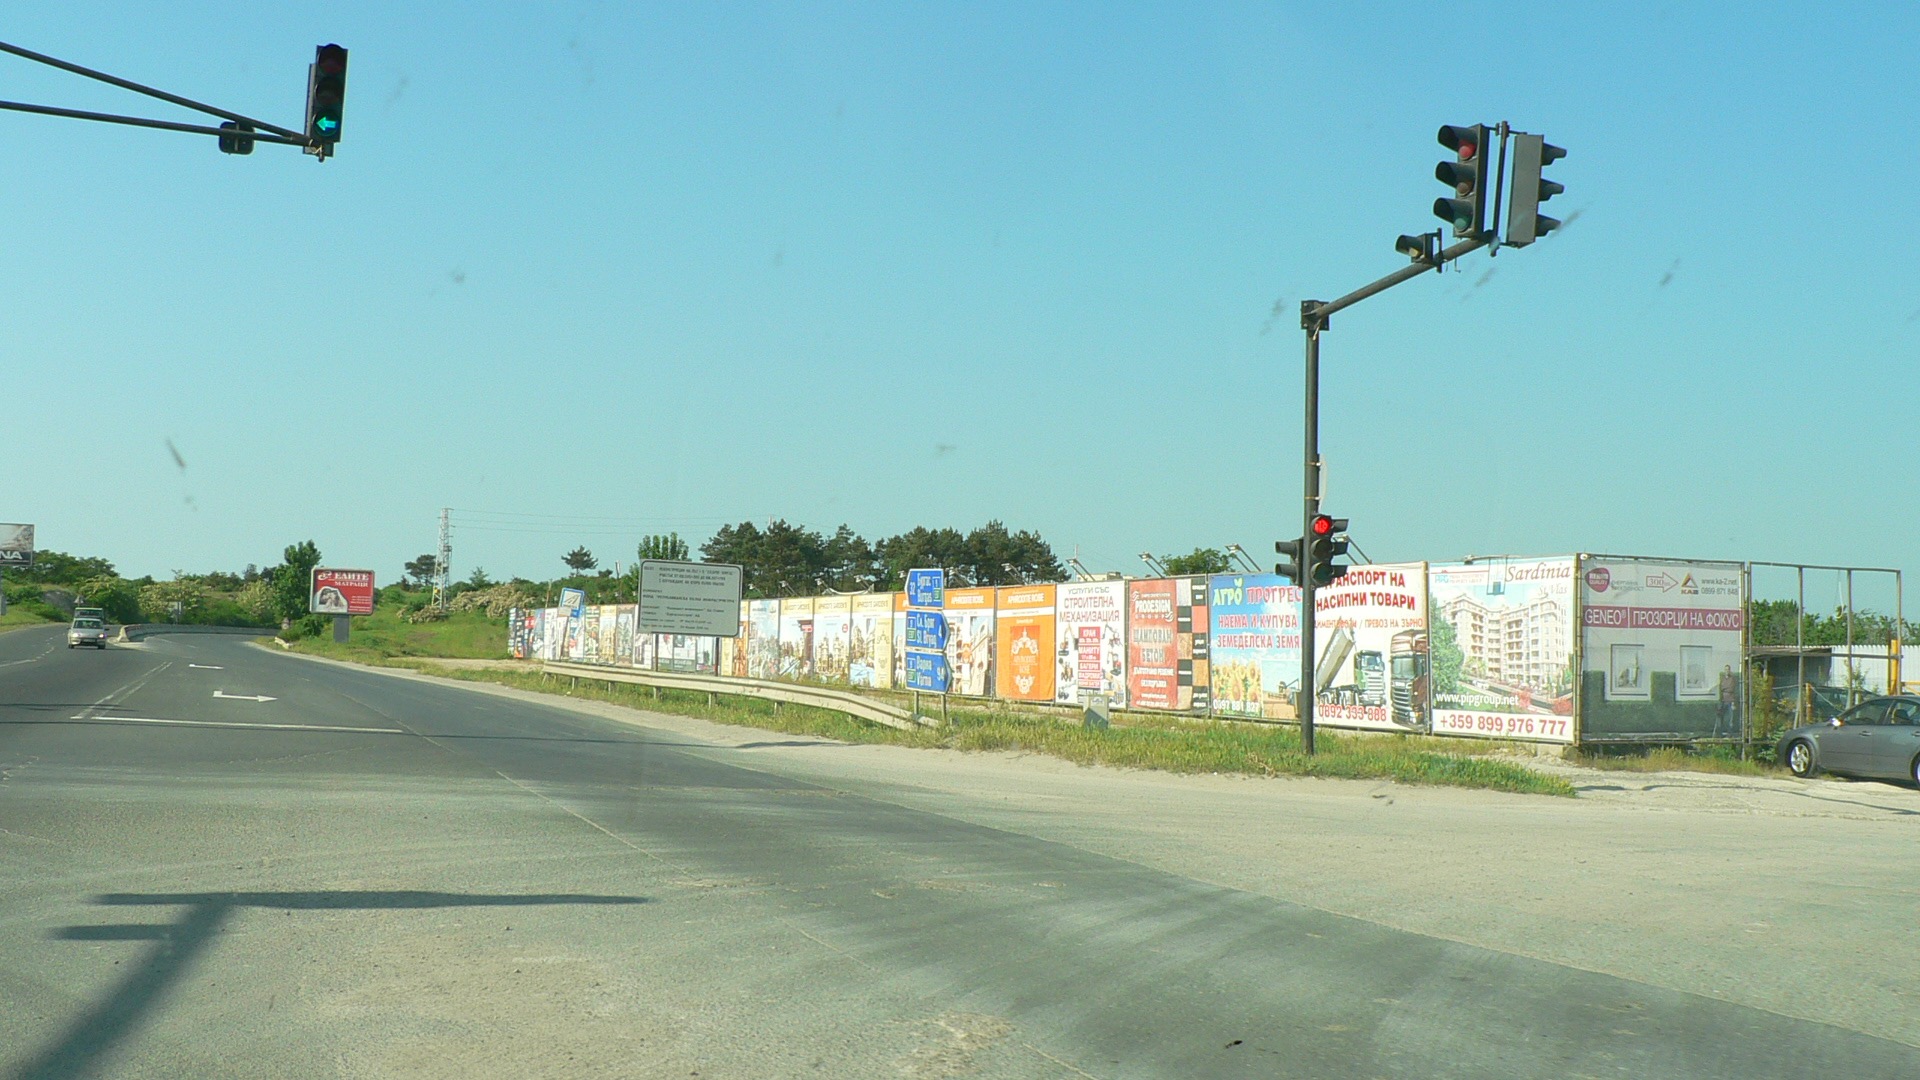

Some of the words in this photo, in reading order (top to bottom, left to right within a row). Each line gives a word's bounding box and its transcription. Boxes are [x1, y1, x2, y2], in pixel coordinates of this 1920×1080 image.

[1390, 571, 1406, 588] НА
[1505, 562, 1571, 582] Sardinia
[1649, 578, 1664, 586] 300
[1067, 587, 1094, 595] УСЛУГИ
[1095, 586, 1110, 594] СЪС
[1212, 580, 1243, 606] АГРО
[1246, 585, 1303, 604] ПРОГРЕС
[1064, 595, 1115, 609] СТРОИТЕЛНА
[1134, 599, 1171, 613] PRODESIGN
[1316, 592, 1367, 613] НАСИПНИ
[1370, 591, 1416, 611] ТОВАРИ
[1059, 610, 1120, 623] МЕХАНИЗАЦИЯ
[1218, 614, 1249, 629] НАЕМА
[1251, 614, 1259, 628] И
[1260, 614, 1299, 629] КУПУВА
[1364, 618, 1388, 629] ПРЕВОЗ
[1390, 618, 1400, 628] НА
[1401, 618, 1423, 629] ЗЪРНО
[1632, 610, 1688, 628] ПРОЗОРЦИ
[1690, 612, 1704, 627] НА
[1705, 612, 1740, 628] ФОКУС
[1133, 628, 1173, 644] ЩАМПОВАН
[1217, 634, 1273, 650] ЗЕМЕДЕЛСКА
[1276, 634, 1301, 649] ЗЕМЯ
[1141, 648, 1165, 663] БЕТОН
[1435, 692, 1519, 708] www.pipgroup.net
[1318, 703, 1342, 719] 0892
[1367, 706, 1387, 722] 888
[1440, 713, 1473, 730] +359
[1477, 715, 1504, 732] 899
[1507, 717, 1534, 734] 976
[1539, 719, 1567, 736] 777
